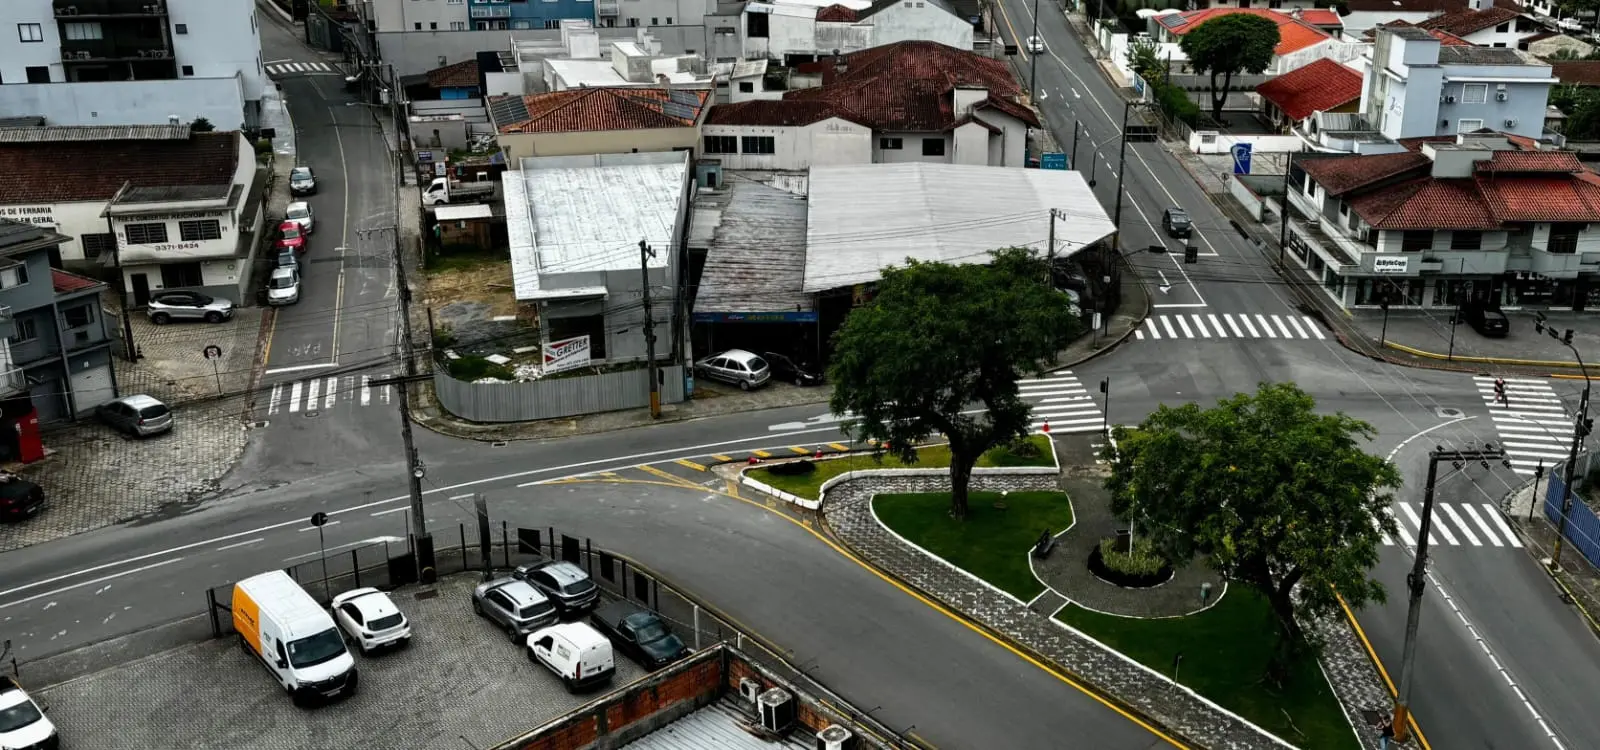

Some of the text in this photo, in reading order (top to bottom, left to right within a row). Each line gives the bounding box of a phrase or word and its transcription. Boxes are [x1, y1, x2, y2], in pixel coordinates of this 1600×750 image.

[8, 207, 17, 215] DE
[19, 206, 52, 214] FERRARIA
[556, 337, 588, 357] GRETTER
